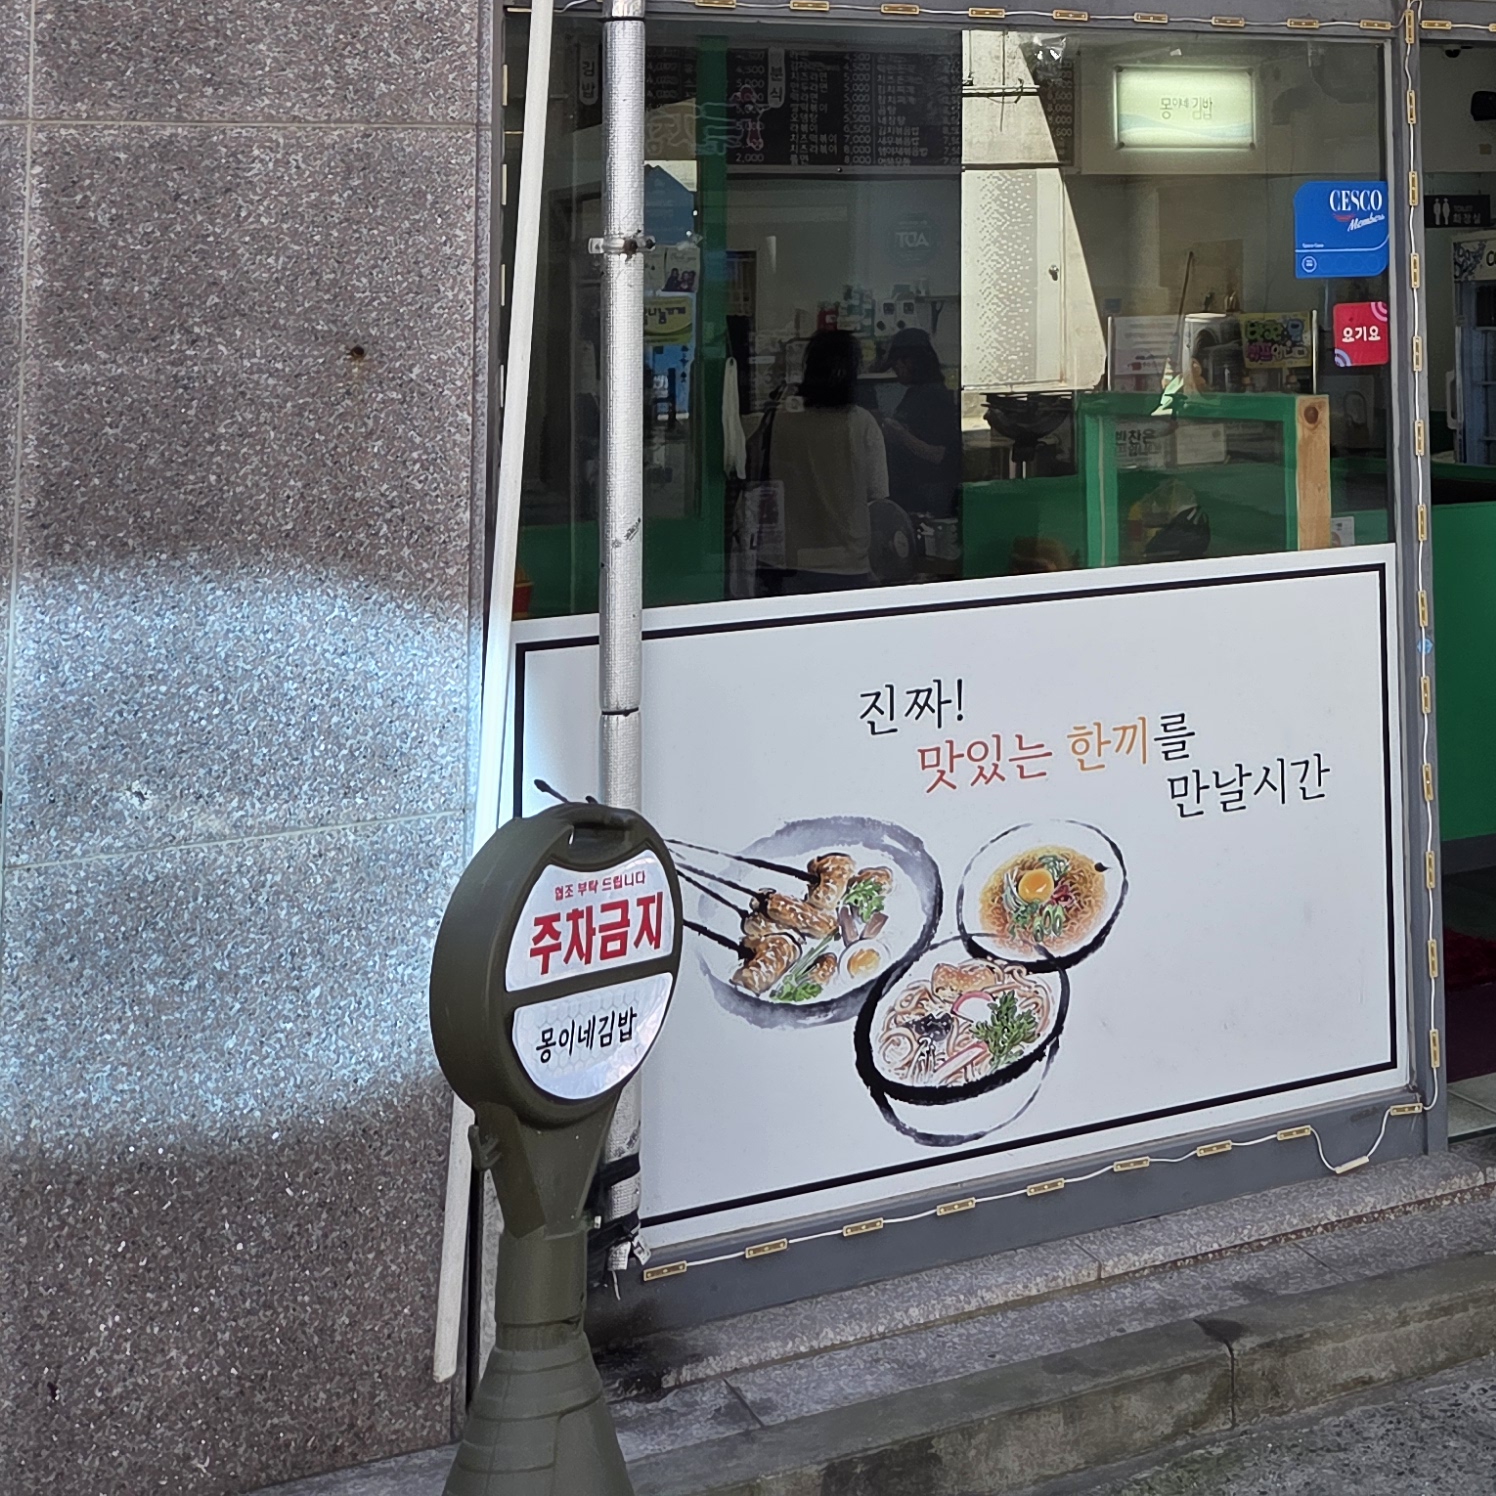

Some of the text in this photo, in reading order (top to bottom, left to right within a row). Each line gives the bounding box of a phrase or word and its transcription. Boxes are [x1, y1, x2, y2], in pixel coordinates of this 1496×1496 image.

[1329, 188, 1384, 212] CESCO
[1347, 212, 1386, 232] Members
[1341, 325, 1382, 343] 요기요
[858, 678, 965, 736] 진짜!
[917, 712, 1196, 794] 맛있는 한끼를
[1168, 753, 1332, 819] 만날시간
[555, 870, 646, 902] 협조 부탁 드립니다
[529, 891, 663, 976] 주차금지
[535, 1006, 637, 1064] 몽이네김밥
